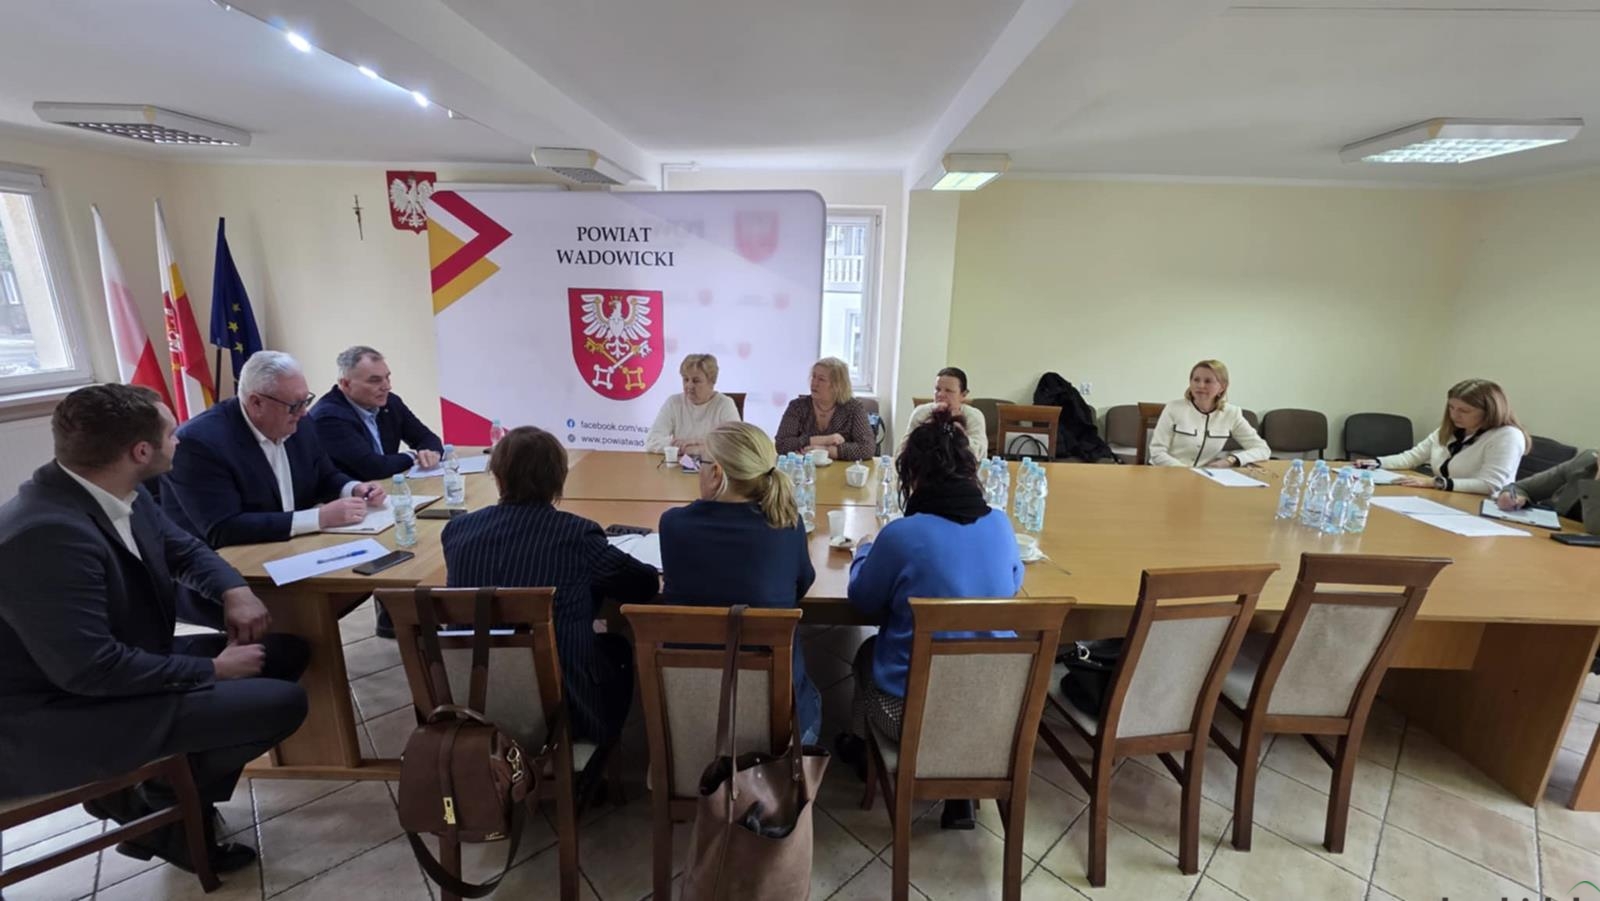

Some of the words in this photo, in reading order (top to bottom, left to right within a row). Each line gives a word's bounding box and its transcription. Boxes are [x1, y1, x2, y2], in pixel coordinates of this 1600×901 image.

[577, 226, 652, 242] POWIAT
[557, 249, 674, 267] WADOWICKI
[581, 421, 649, 433] facebook.com/wa
